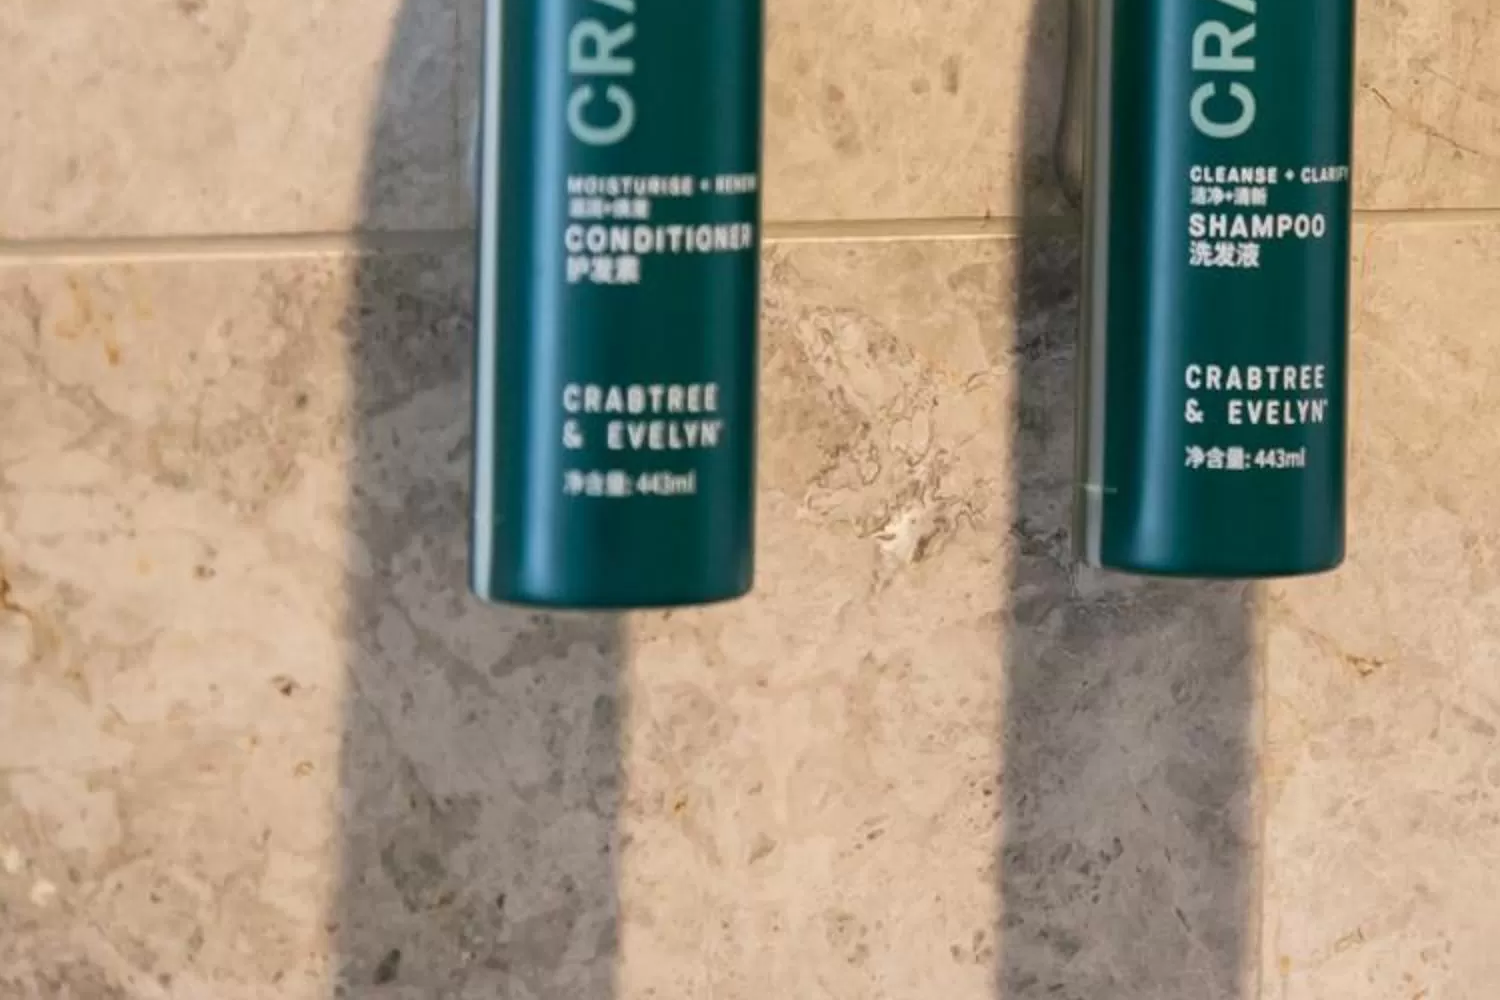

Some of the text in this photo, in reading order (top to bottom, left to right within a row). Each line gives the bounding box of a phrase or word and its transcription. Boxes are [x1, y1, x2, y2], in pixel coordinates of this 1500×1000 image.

[1189, 165, 1278, 184] CLEANSE
[565, 222, 752, 253] CONDITIONER
[1188, 213, 1325, 238] SHAMPOO
[1185, 364, 1325, 391] CRABTREE
[563, 382, 718, 414] CRABTREE
[1184, 398, 1204, 424] &
[562, 419, 583, 448] &
